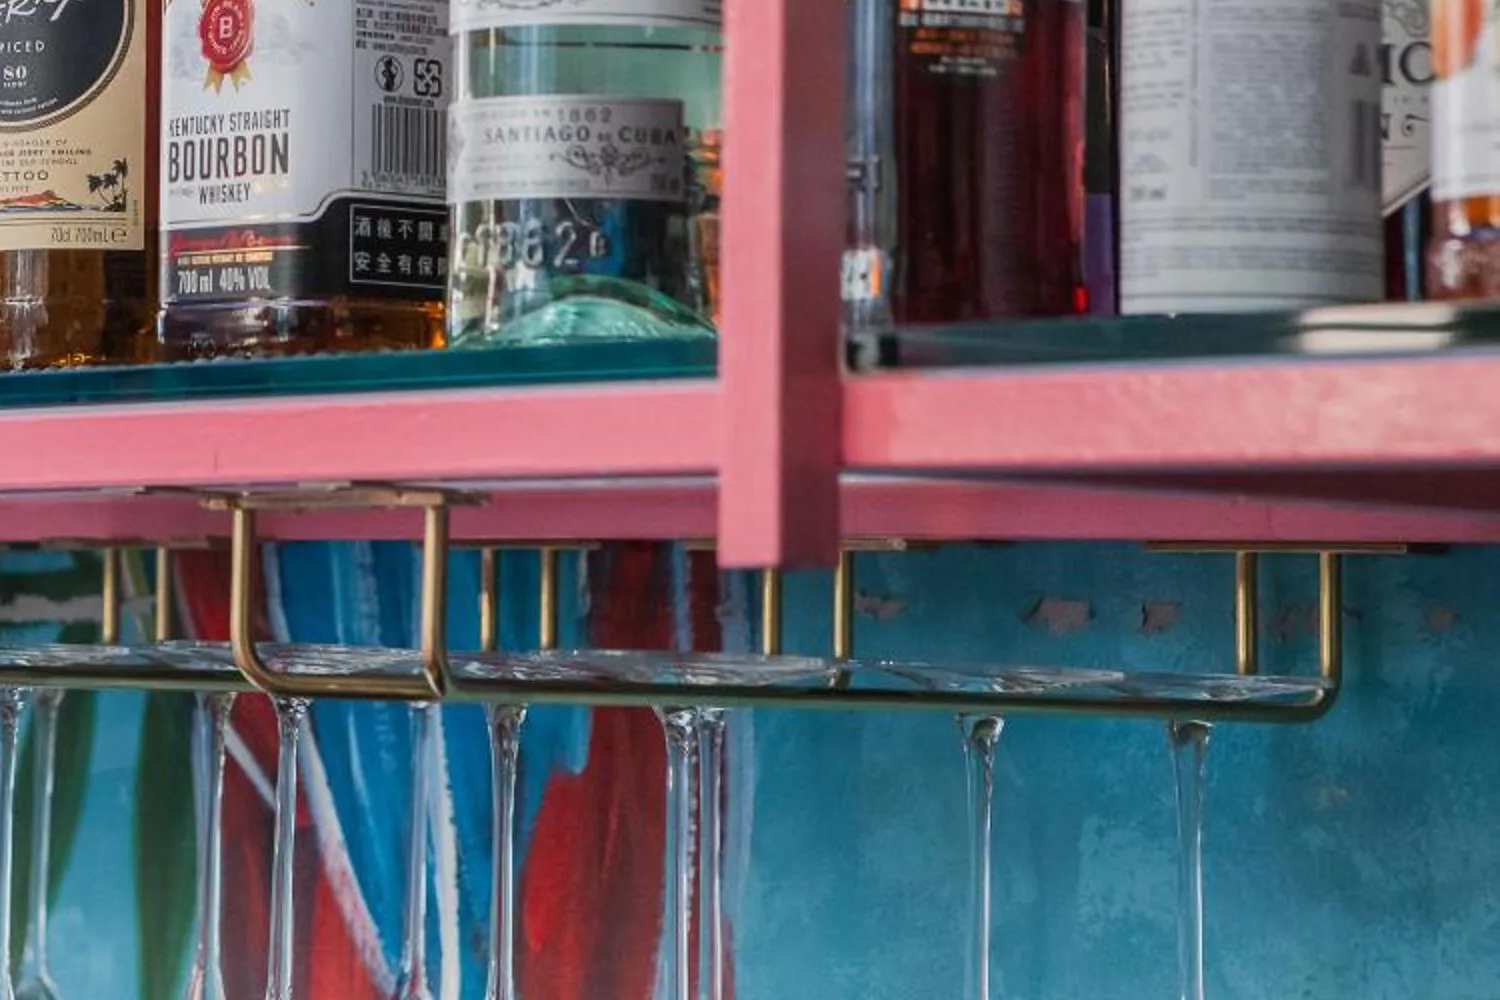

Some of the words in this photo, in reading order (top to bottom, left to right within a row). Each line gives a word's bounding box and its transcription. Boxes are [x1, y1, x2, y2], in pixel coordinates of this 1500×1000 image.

[219, 16, 233, 39] B
[3, 65, 27, 81] 80
[169, 114, 225, 137] KENTUCKY
[229, 108, 291, 133] STRAIGHT
[558, 106, 613, 124] 1862
[483, 124, 592, 145] SANTIAGO
[618, 125, 677, 145] CUBA
[168, 132, 289, 183] BOURBON
[198, 182, 251, 205] WHISKEY
[219, 267, 245, 292] 40%
